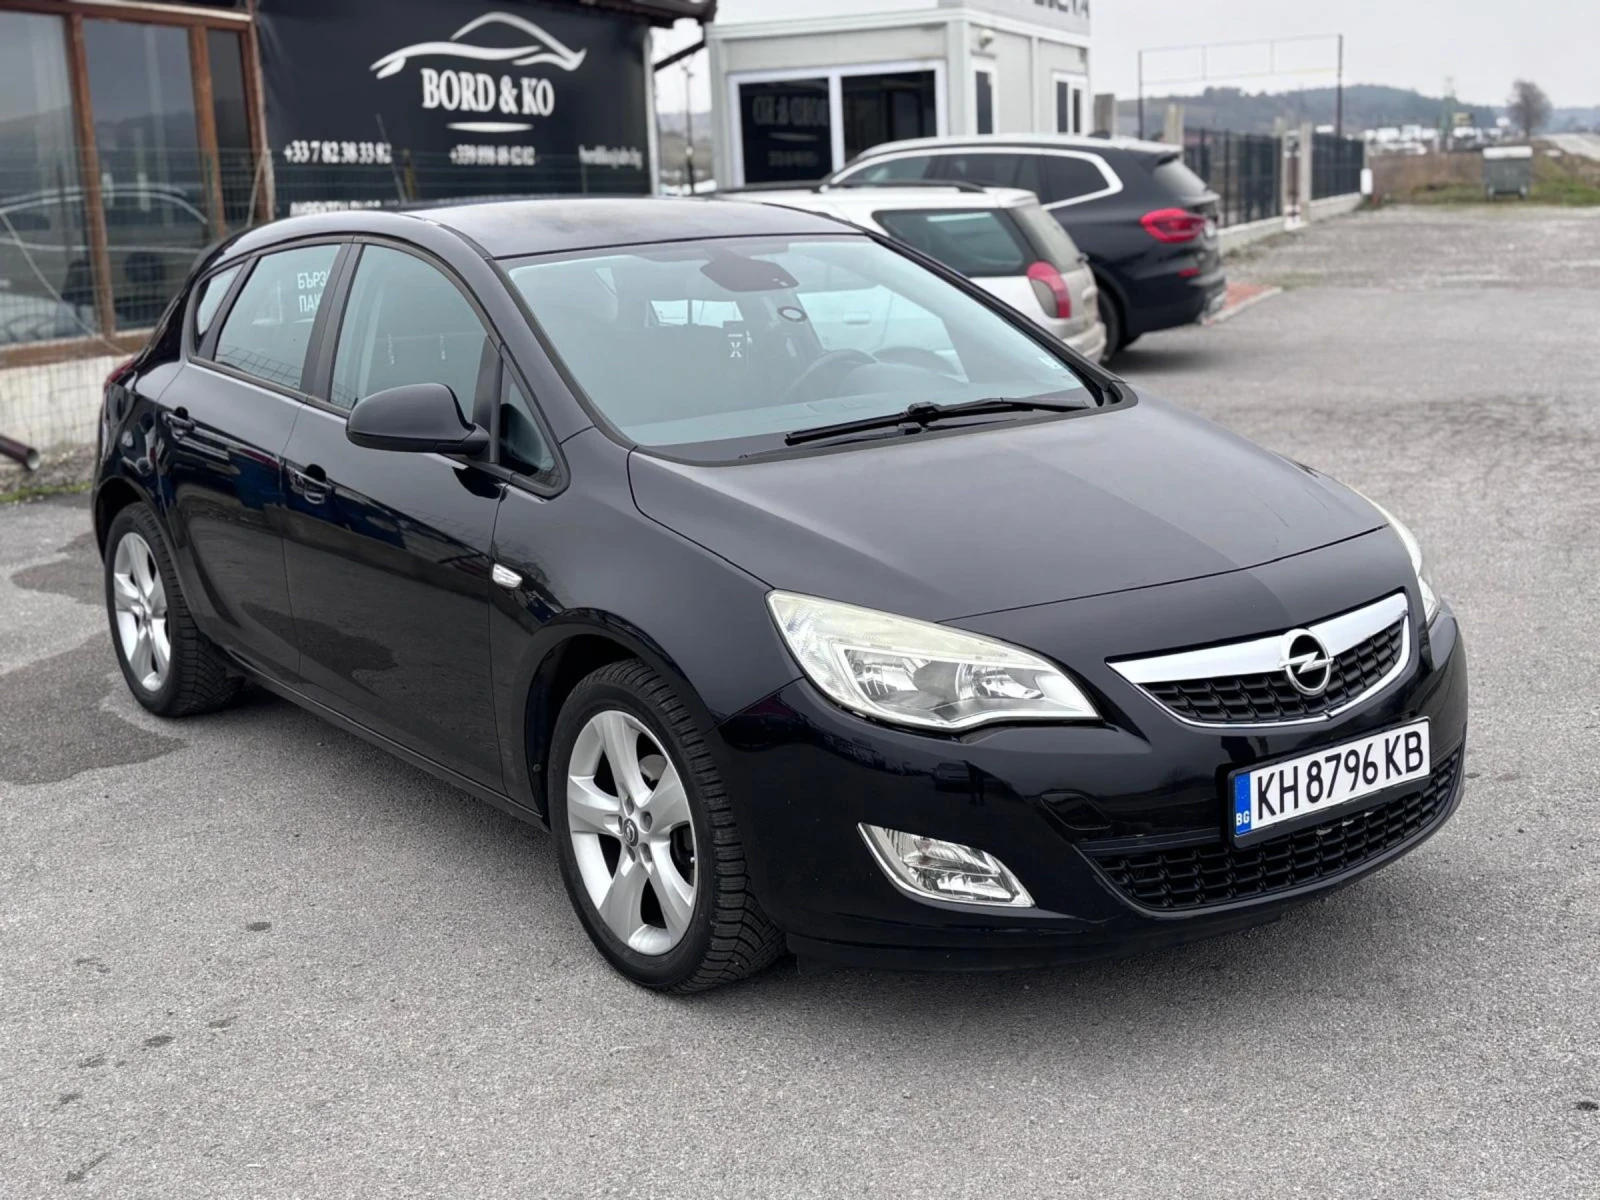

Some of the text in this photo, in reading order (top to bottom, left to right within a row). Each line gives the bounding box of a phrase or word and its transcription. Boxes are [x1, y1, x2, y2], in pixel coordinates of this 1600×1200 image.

[420, 67, 555, 117] BORD & KO
[297, 269, 330, 289] БЪРЗ
[1235, 810, 1250, 827] BG
